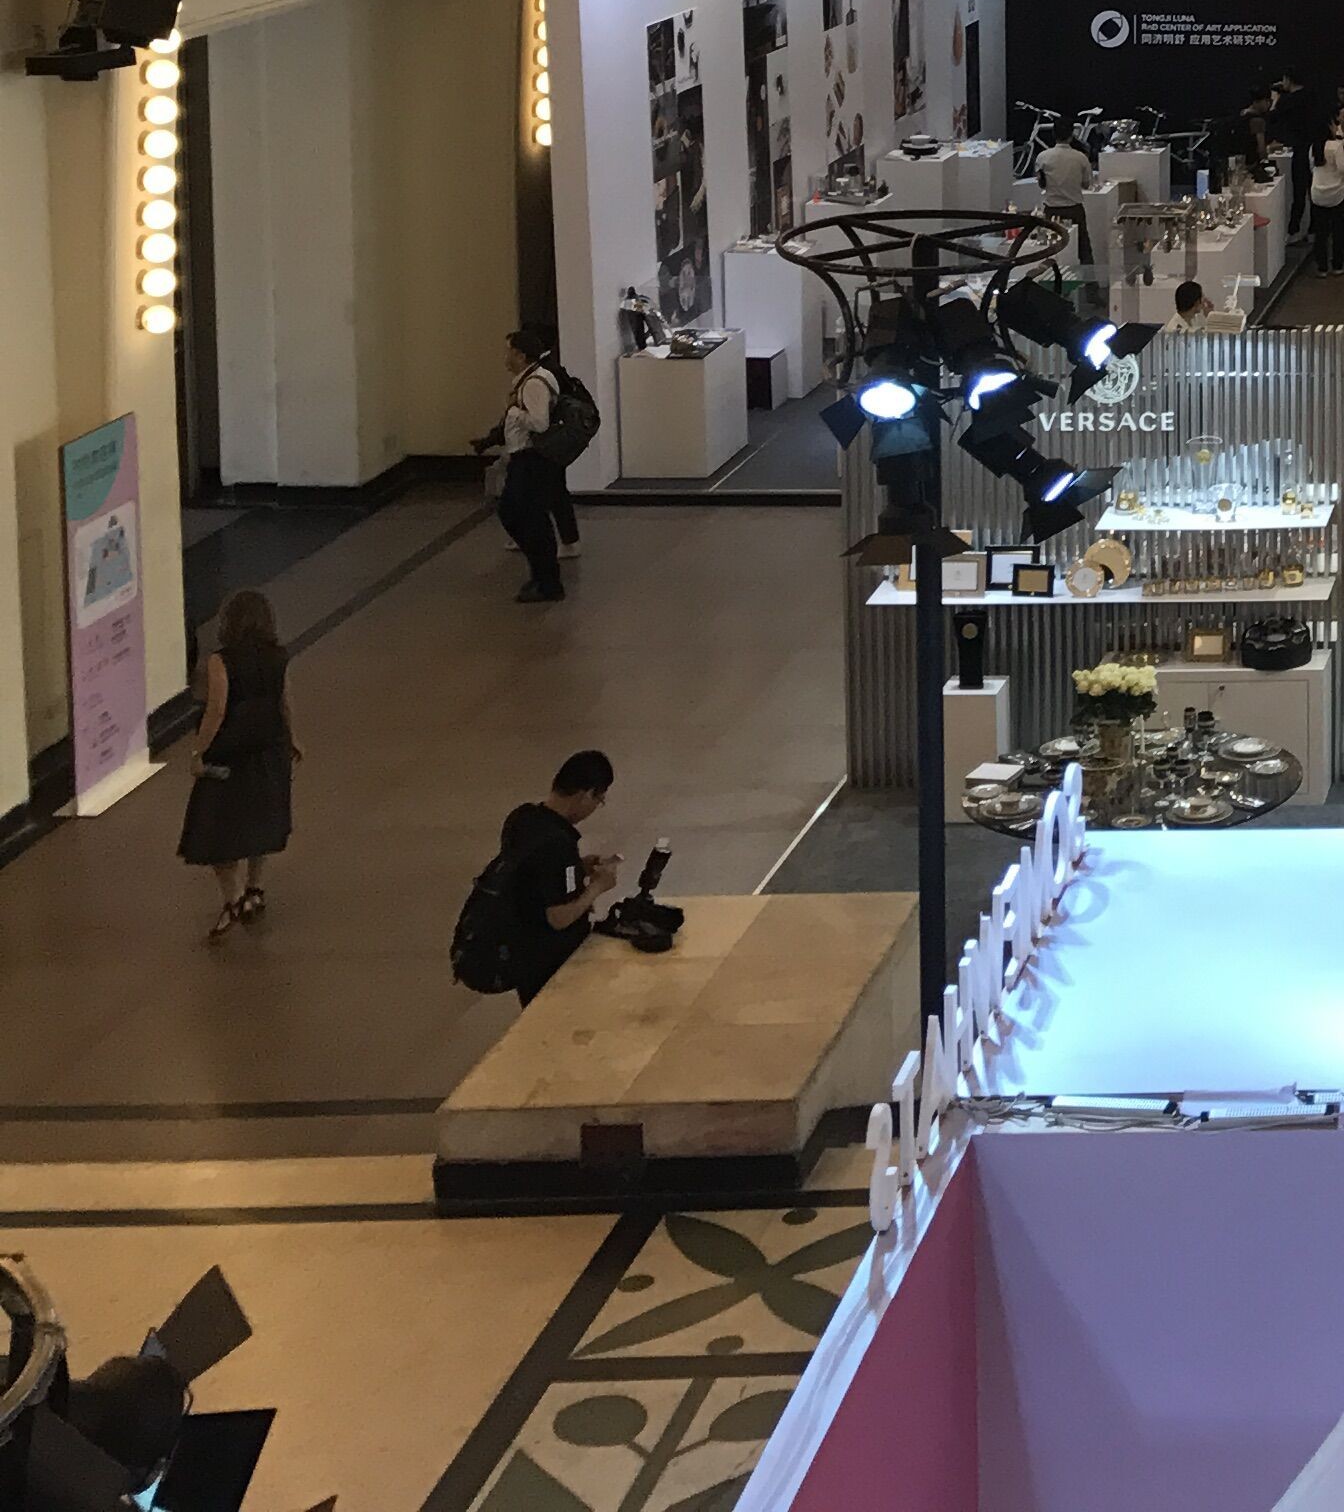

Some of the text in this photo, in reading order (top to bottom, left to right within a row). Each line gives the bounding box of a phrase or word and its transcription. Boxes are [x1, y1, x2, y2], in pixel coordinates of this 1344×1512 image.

[1173, 14, 1196, 23] LUNA
[1159, 23, 1192, 33] CENTER
[1193, 23, 1204, 33] OF
[1205, 24, 1222, 33] ART
[1223, 24, 1277, 34] APPLICATION
[1038, 411, 1176, 433] VERSACE
